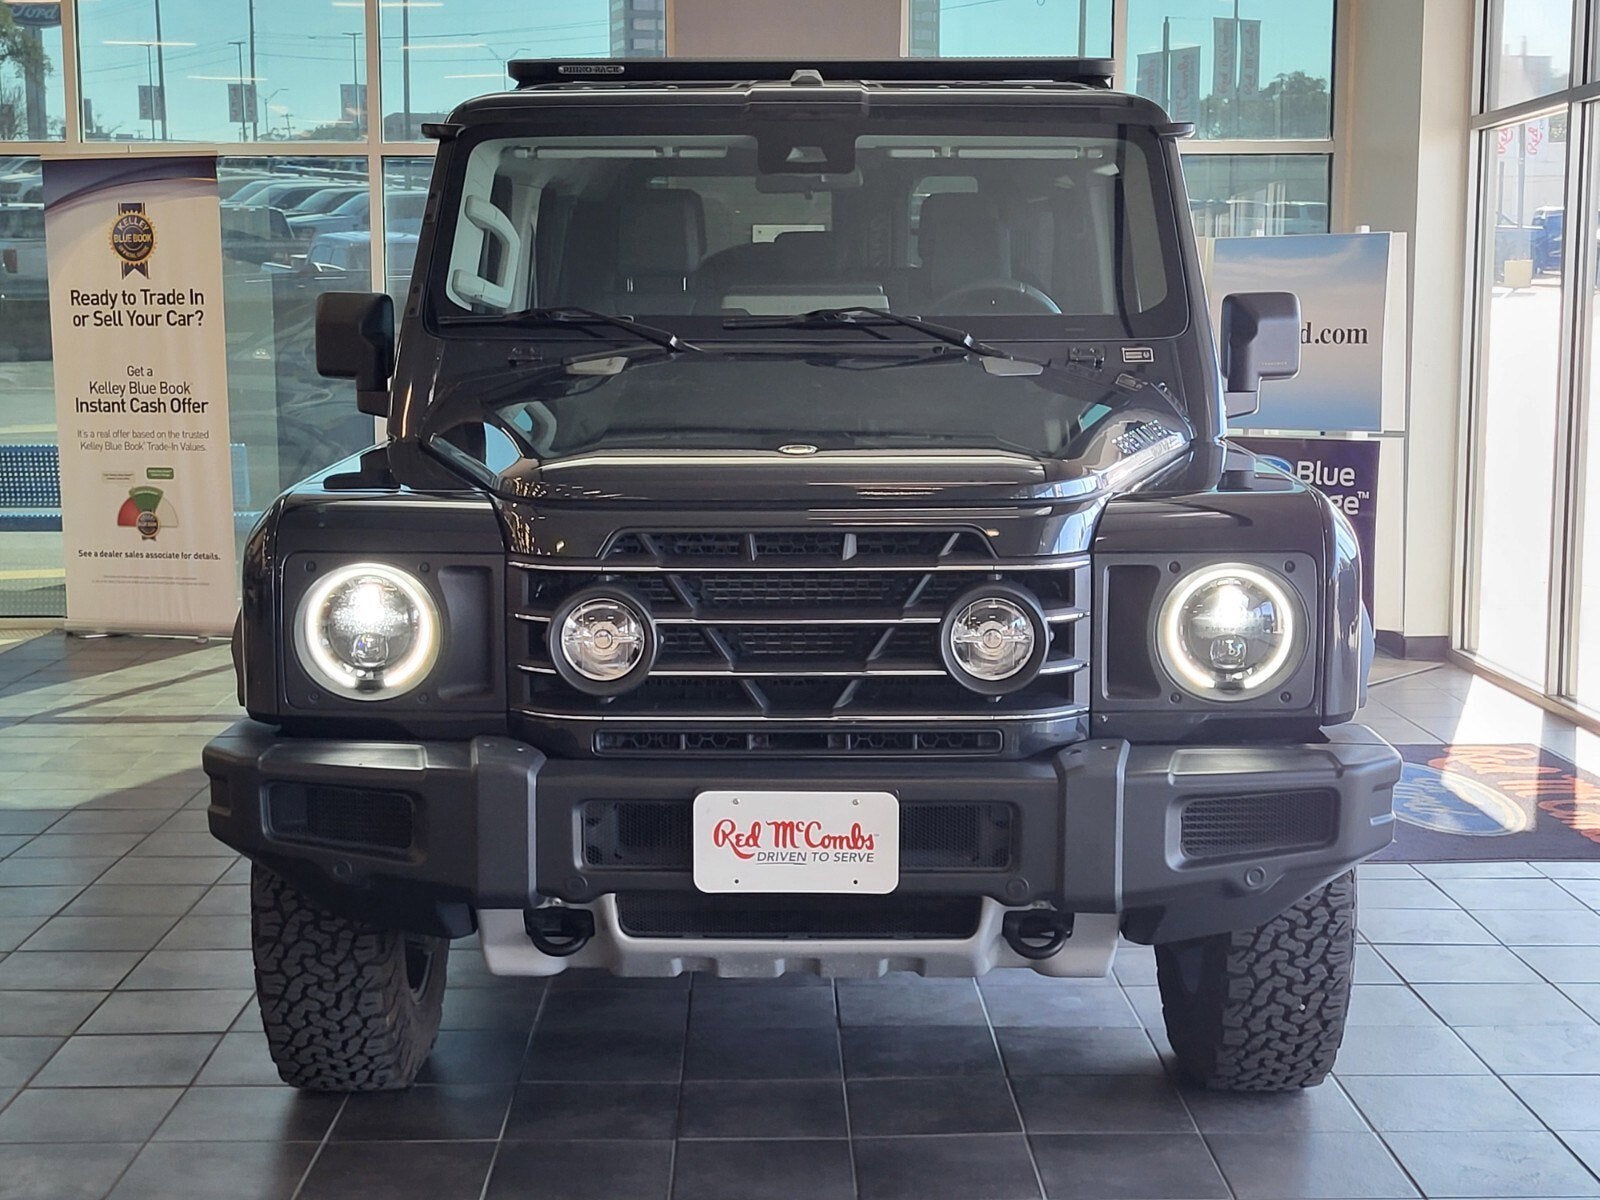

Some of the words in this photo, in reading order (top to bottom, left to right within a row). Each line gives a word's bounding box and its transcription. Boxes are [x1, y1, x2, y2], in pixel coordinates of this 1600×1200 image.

[117, 216, 150, 231] KELLEY
[114, 234, 132, 243] BLUE
[133, 233, 152, 243] BOOK
[70, 289, 118, 309] Ready
[121, 290, 137, 306] to
[140, 289, 185, 306] Trade
[189, 288, 205, 305] In
[73, 314, 89, 327] or
[93, 310, 123, 327] Sell
[126, 310, 162, 327] Your
[166, 309, 204, 327] Car?
[127, 365, 145, 377] Get
[146, 368, 153, 377] a
[89, 381, 126, 397] Kelley
[129, 381, 157, 395] Blue
[159, 381, 191, 395] Book
[75, 397, 126, 413] Instant
[130, 397, 167, 413] Cash
[170, 397, 209, 413] Offer
[77, 429, 88, 438] It's
[96, 429, 111, 438] real
[112, 429, 130, 438] offer
[131, 430, 155, 439] based
[168, 430, 180, 439] the
[182, 430, 210, 439] trusted
[80, 442, 103, 453] Kelley
[104, 442, 123, 451] Blue
[147, 442, 179, 451] Trade-In
[180, 442, 206, 452] Values.
[1296, 460, 1356, 487] Blue
[78, 549, 92, 558] See
[99, 550, 123, 559] dealer
[125, 550, 144, 559] sales
[145, 550, 180, 560] associate
[181, 551, 191, 560] for
[193, 551, 221, 561] details.
[713, 818, 762, 859] Red
[765, 820, 875, 851] McCombs
[757, 851, 808, 863] DRIVEN
[811, 851, 830, 863] TO
[833, 852, 875, 863] SERVE
